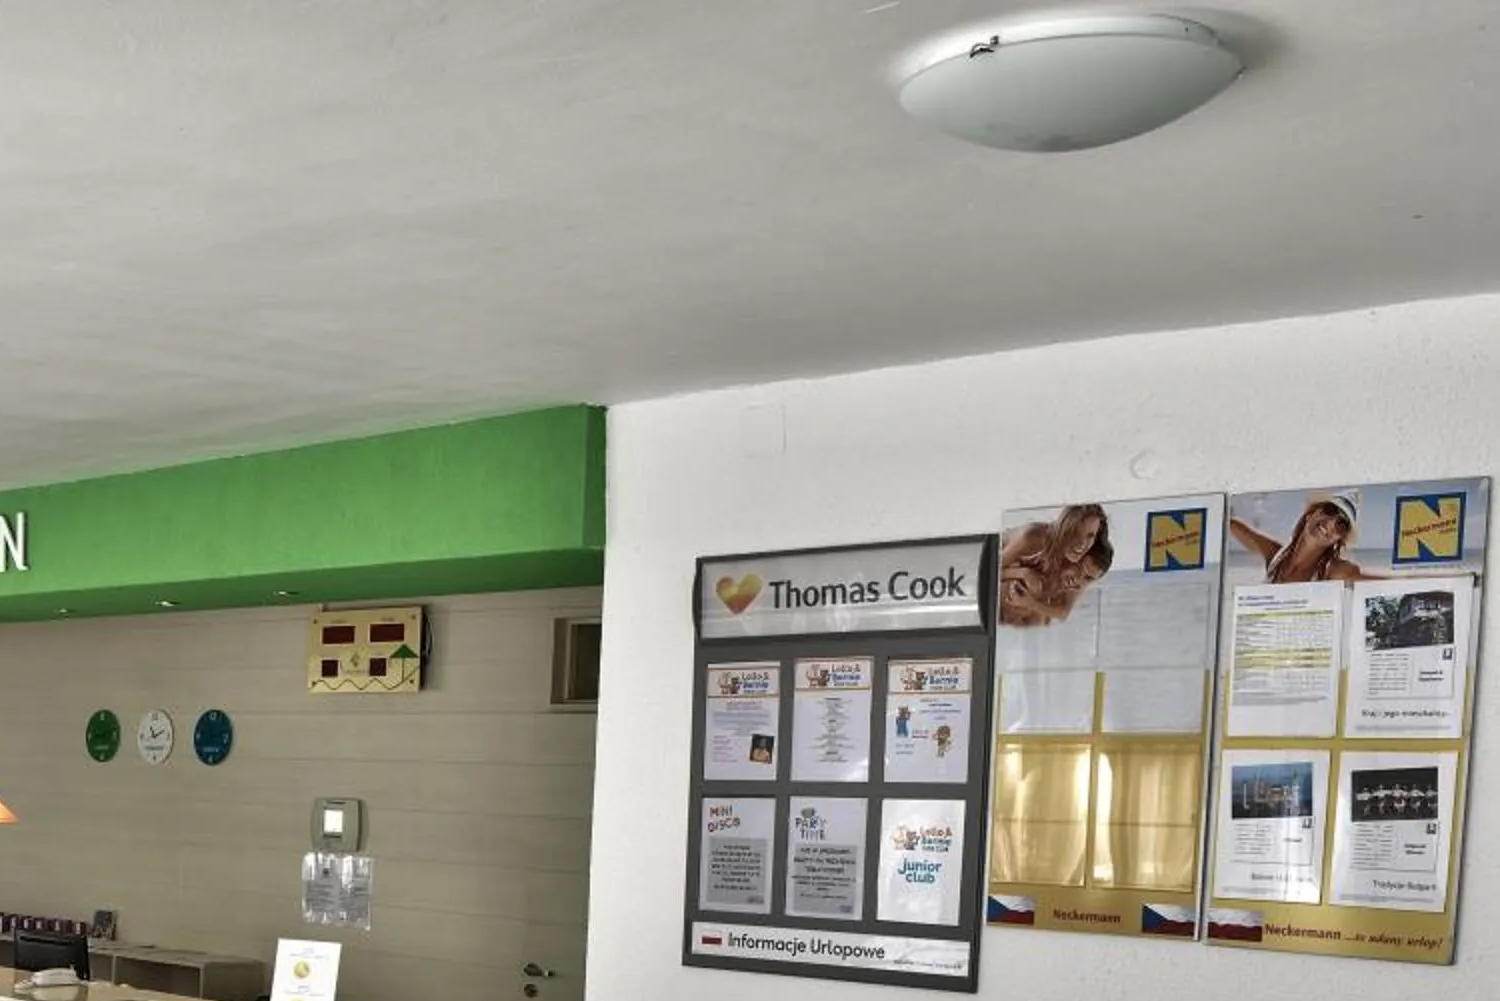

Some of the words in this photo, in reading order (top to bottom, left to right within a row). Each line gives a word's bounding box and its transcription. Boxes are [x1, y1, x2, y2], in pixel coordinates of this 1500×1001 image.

[768, 580, 880, 609] Thomas
[888, 566, 965, 600] Cook
[897, 857, 943, 875] junior
[905, 872, 936, 884] club
[1265, 924, 1342, 941] Neckermann
[728, 932, 806, 957] Informacje
[811, 940, 885, 960] Urlopowe
